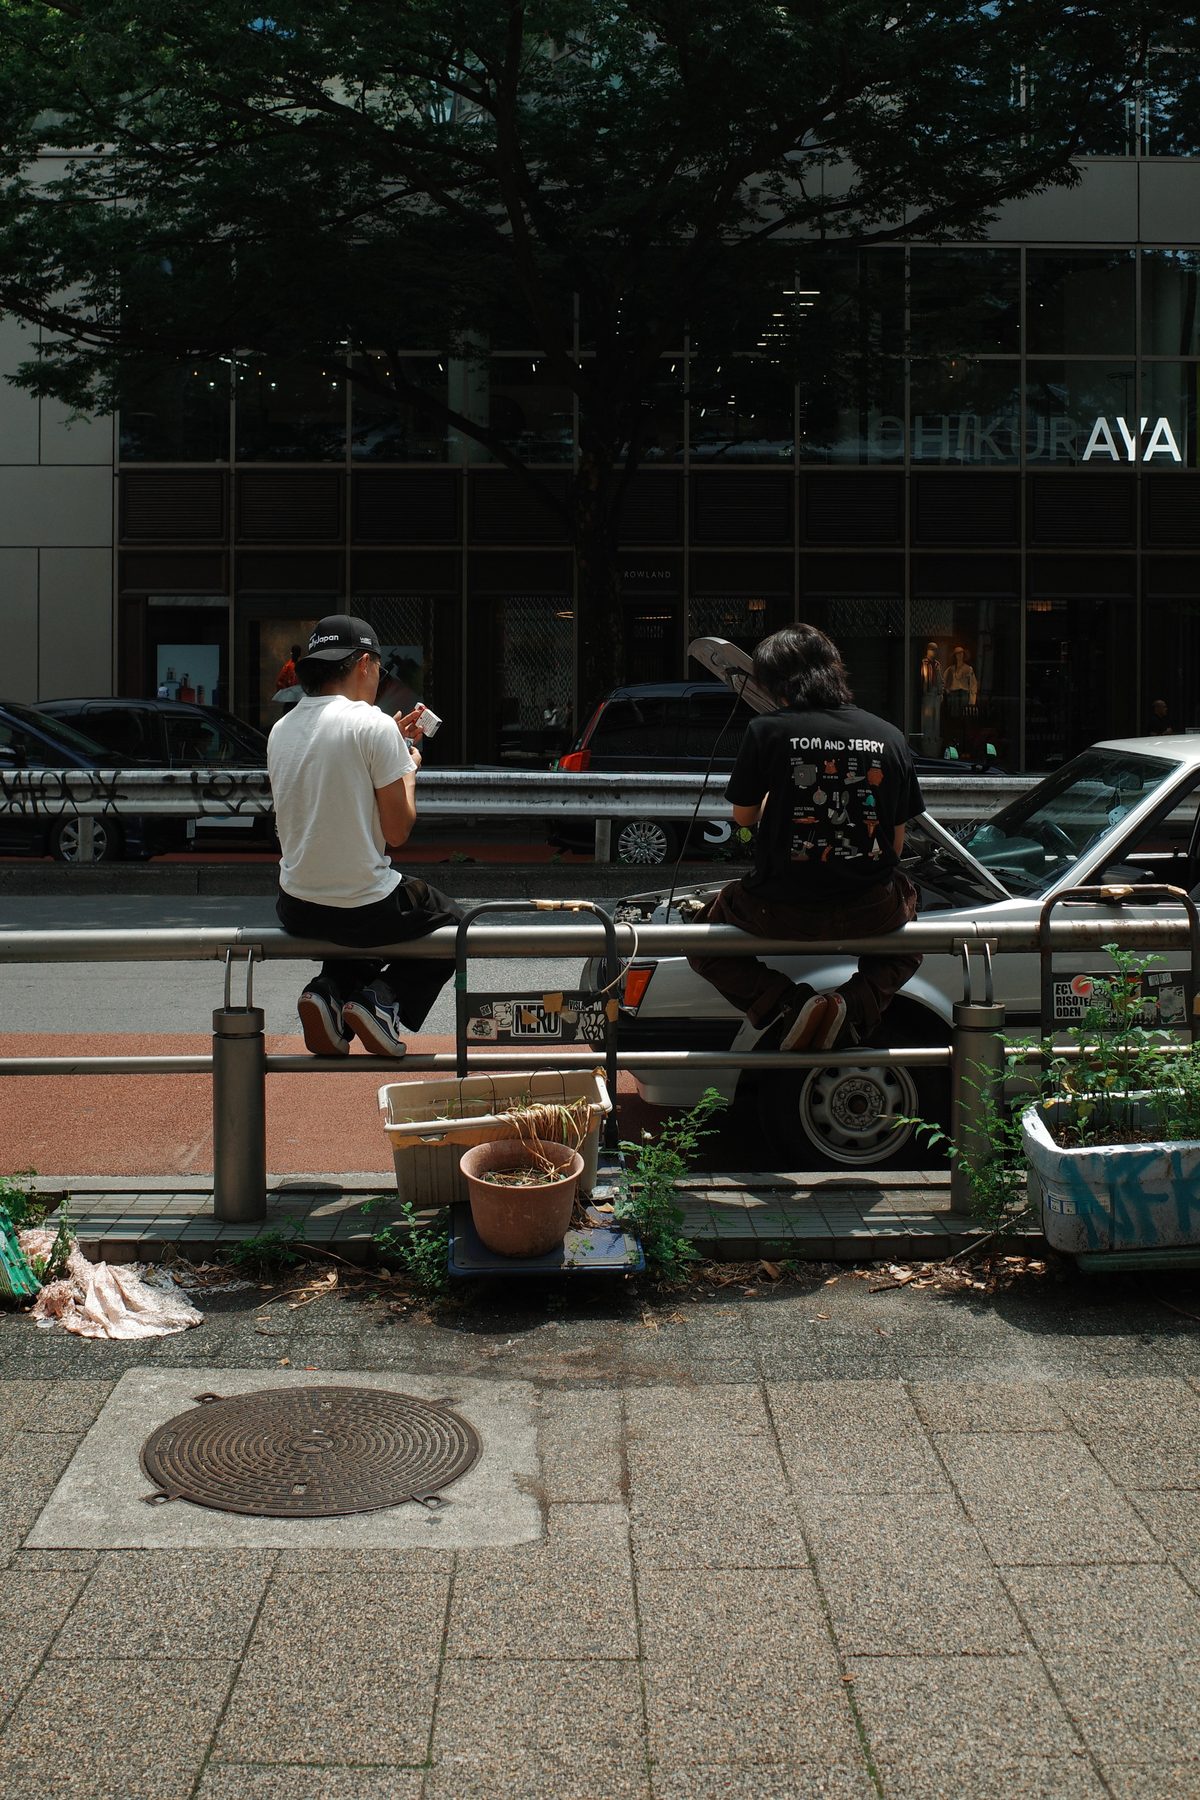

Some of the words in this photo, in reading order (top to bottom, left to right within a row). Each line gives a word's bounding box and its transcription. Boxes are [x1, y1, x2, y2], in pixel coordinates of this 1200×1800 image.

[624, 570, 671, 579] ROWLAND
[790, 737, 822, 750] TOM
[824, 739, 846, 751] AND
[847, 738, 885, 754] JERRY
[1056, 1007, 1081, 1017] ODEN
